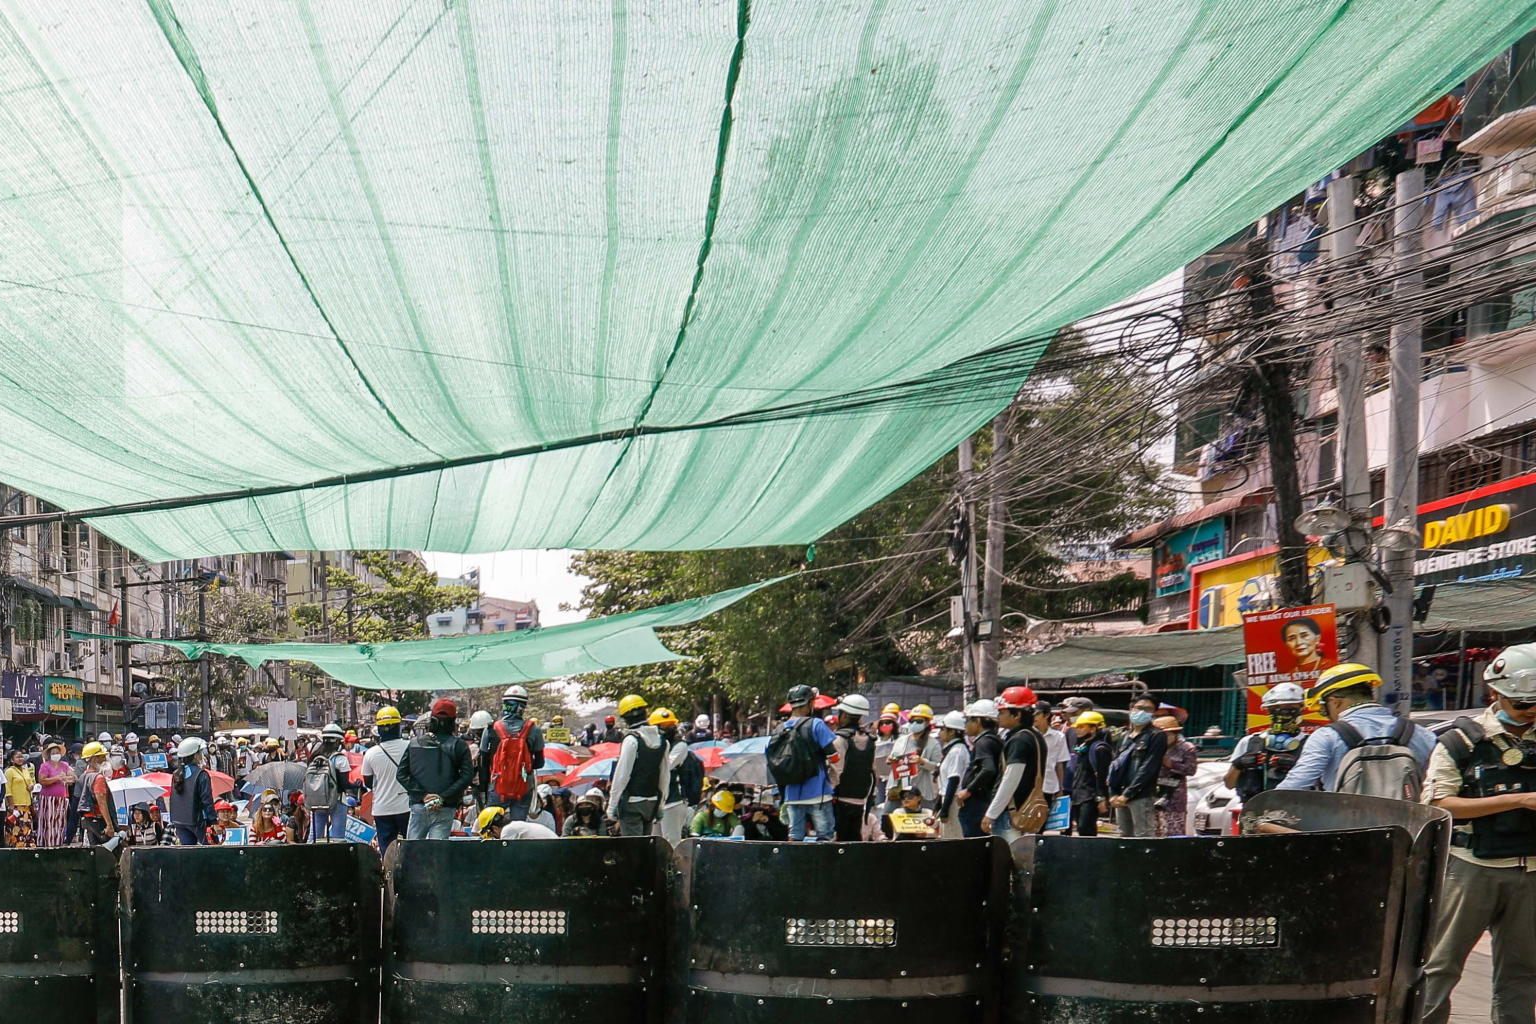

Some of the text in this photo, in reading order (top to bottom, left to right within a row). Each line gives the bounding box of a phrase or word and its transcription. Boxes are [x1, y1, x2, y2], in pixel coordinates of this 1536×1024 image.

[1423, 504, 1511, 550] DAVID
[1413, 546, 1487, 576] VENIENCE
[1488, 535, 1536, 561] STORE
[1247, 651, 1277, 676] FREE
[14, 674, 29, 698] AZ
